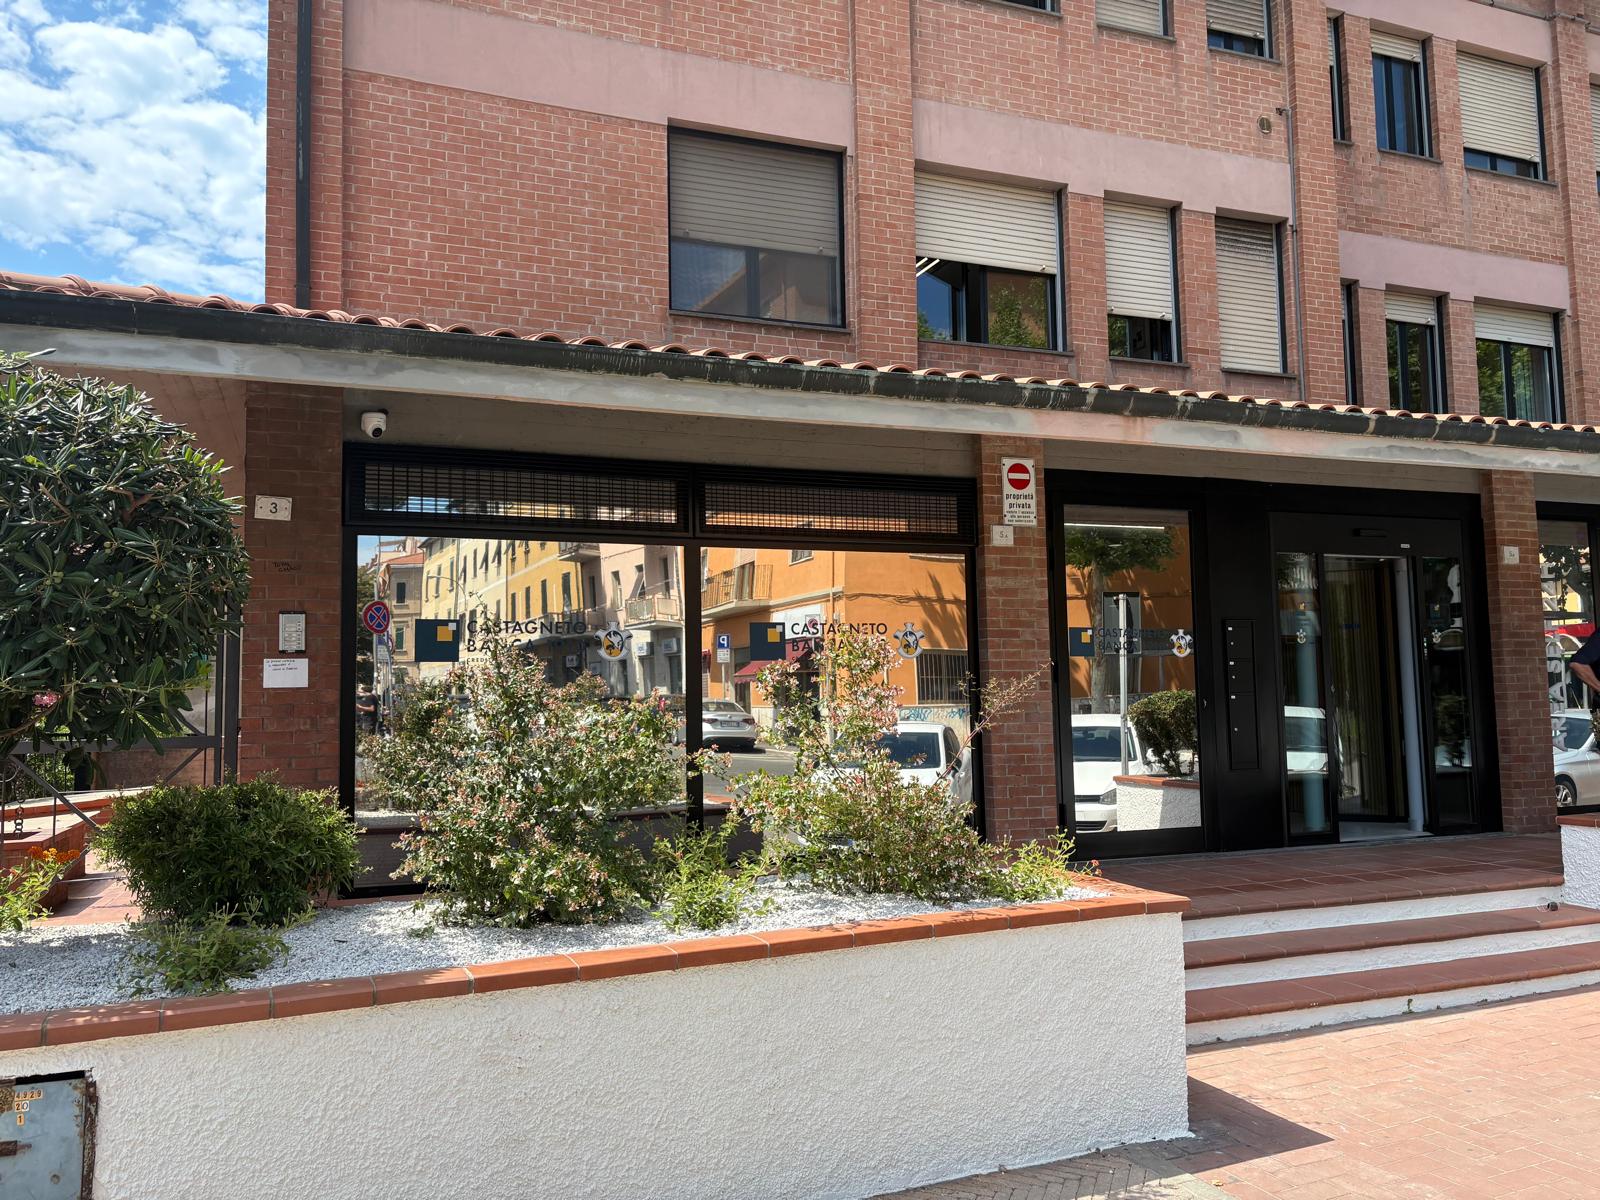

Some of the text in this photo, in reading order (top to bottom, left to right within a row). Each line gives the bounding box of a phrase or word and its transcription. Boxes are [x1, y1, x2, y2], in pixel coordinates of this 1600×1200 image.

[269, 502, 278, 514] 3
[1008, 501, 1032, 509] privata
[467, 620, 587, 635] CASTAGNETO
[15, 1102, 29, 1110] 20
